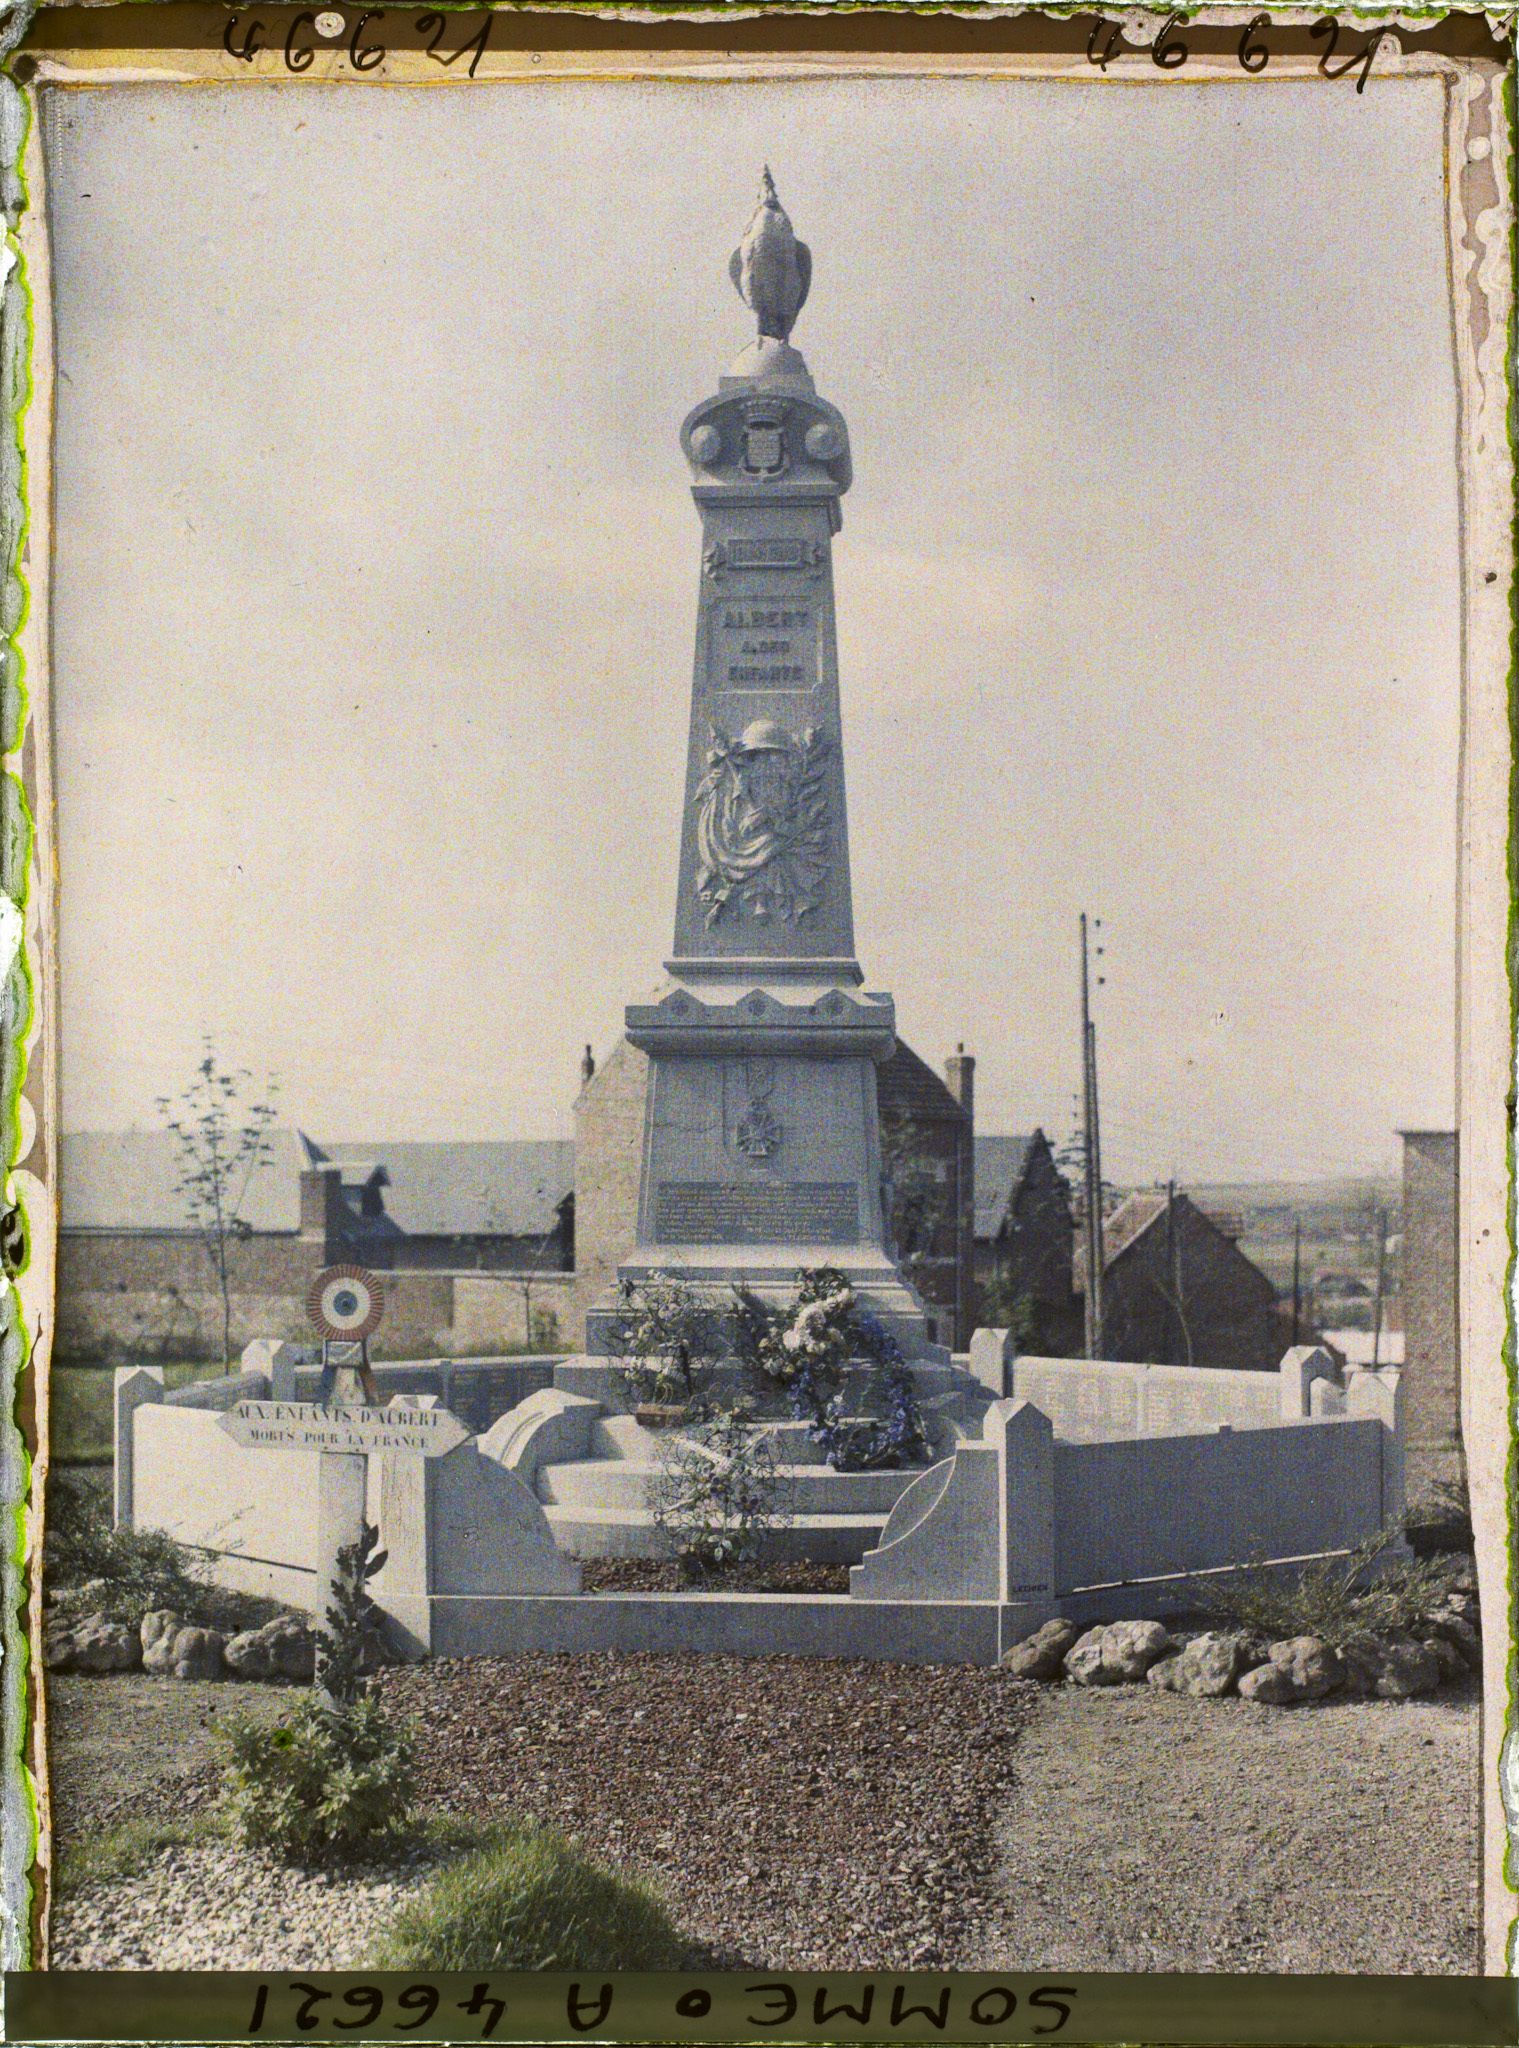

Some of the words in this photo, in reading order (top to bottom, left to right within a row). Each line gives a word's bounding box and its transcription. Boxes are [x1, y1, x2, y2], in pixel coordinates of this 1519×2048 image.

[223, 11, 493, 78] 46621
[1087, 10, 1388, 94] 46621
[304, 1432, 339, 1444] POUR
[348, 1434, 365, 1446] LA
[373, 1434, 429, 1449] FRANCE
[248, 1982, 507, 2038] 46621
[567, 1983, 613, 2032] A
[745, 1983, 1078, 2034] SOMME
